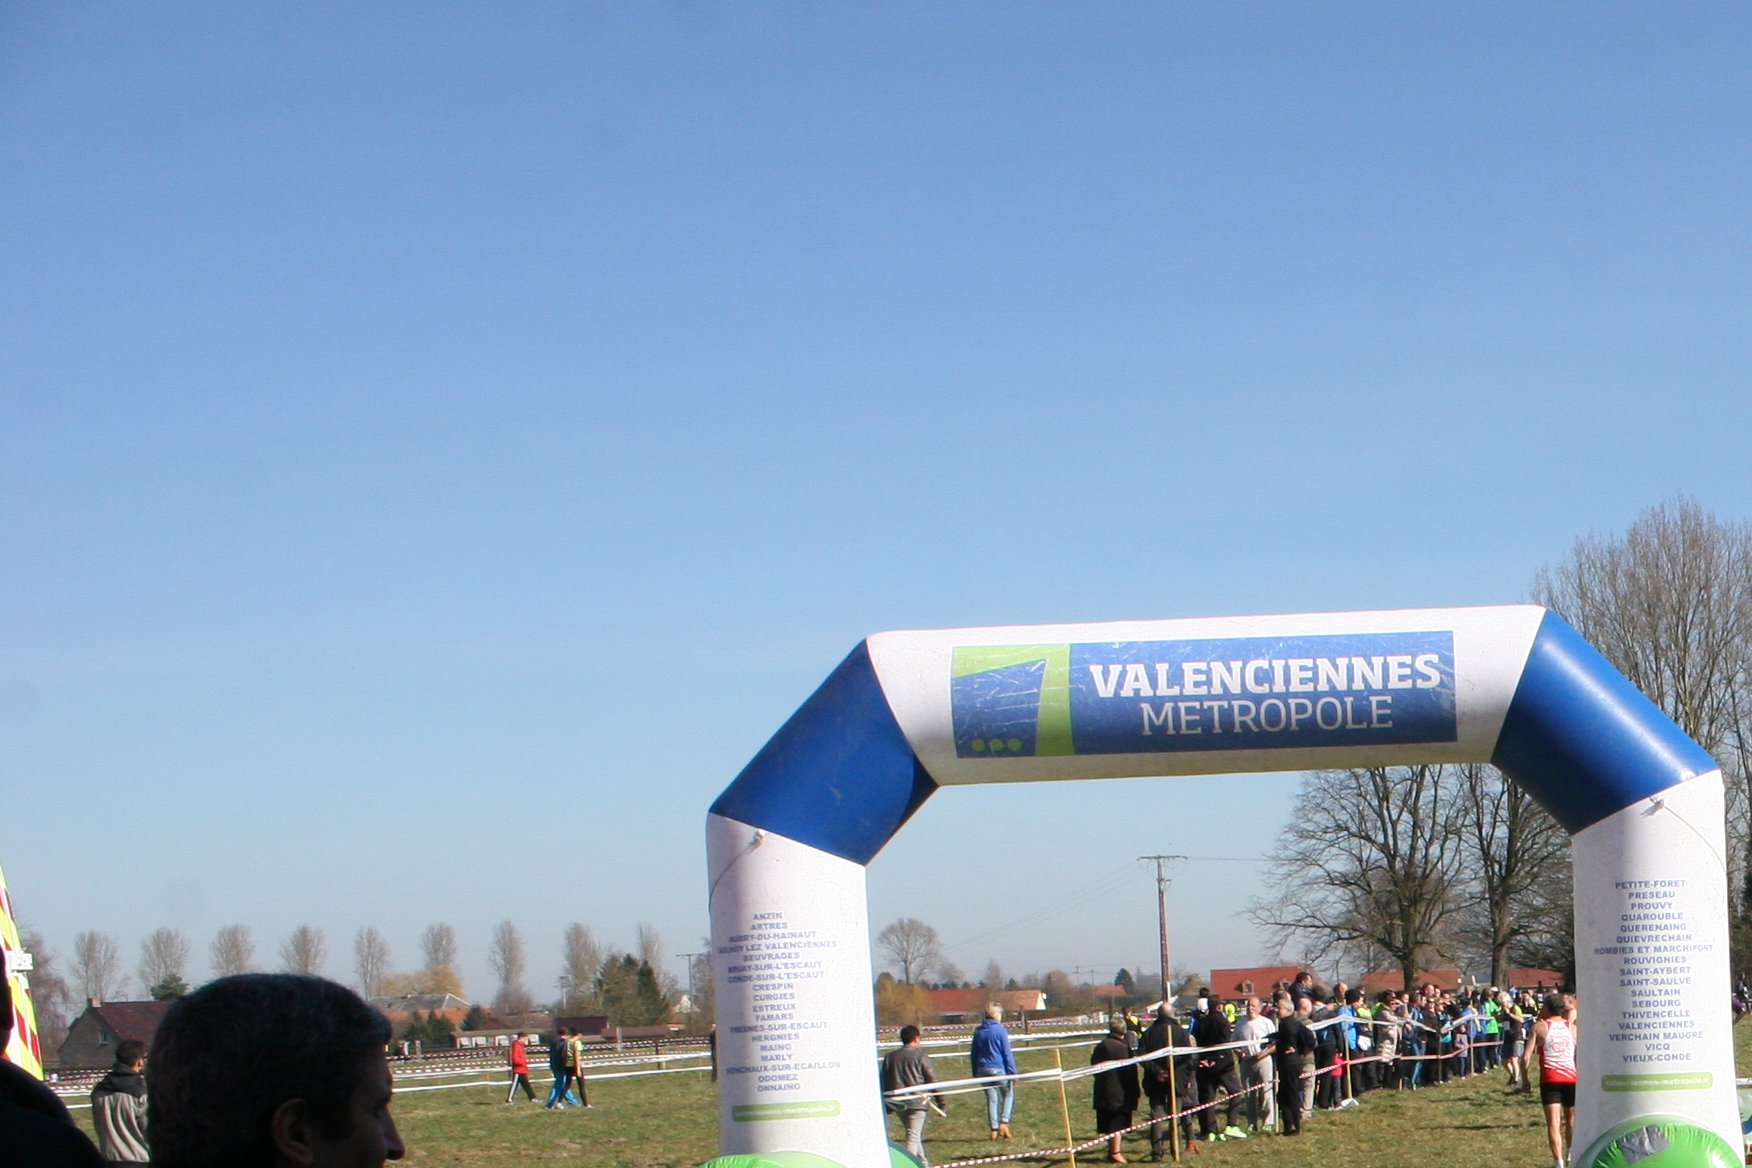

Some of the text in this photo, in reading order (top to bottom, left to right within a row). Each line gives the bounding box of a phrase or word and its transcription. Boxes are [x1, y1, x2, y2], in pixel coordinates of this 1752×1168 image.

[1090, 654, 1440, 698] VALENCIENNES
[1141, 696, 1393, 736] METROPOLE
[1615, 881, 1687, 890] PETITE-FORET
[1628, 891, 1676, 900] PRESEAU
[1631, 902, 1674, 911] PROUVY
[753, 913, 783, 921] ANZIN
[1621, 912, 1684, 922] QUAROUBLE
[751, 922, 788, 931] ARTRES
[1620, 923, 1688, 933] QUERENAING
[1616, 934, 1692, 944] QUIEVRECHAIN
[1594, 944, 1714, 956] ROMBIES ET MARCHIPONT
[743, 953, 801, 962] BEUVRAGES
[1624, 956, 1687, 965] ROUVIGNIES
[1620, 967, 1692, 976] SAINT-AYBERT
[1620, 977, 1692, 987] SAINT-SAULVE
[753, 983, 794, 992] CRESPIN
[753, 993, 796, 1002] CURGIES
[1631, 988, 1681, 998] SAULTAIN
[753, 1003, 797, 1013] ESTREUX
[1632, 999, 1682, 1009] SEBOURG
[756, 1013, 795, 1022] FAMARS
[1622, 1010, 1691, 1020] THIVENCELLE
[1619, 1021, 1695, 1031] VALENCIENNES
[752, 1033, 801, 1043] HERGNIES
[1609, 1031, 1704, 1042] VERCHAIN MAUGRE
[760, 1043, 792, 1052] MAING
[1645, 1043, 1671, 1053] VICQ
[761, 1054, 793, 1062] MARLY
[1623, 1054, 1692, 1063] VIEUX-CONDE
[758, 1074, 799, 1083] ODOMEZ
[757, 1084, 801, 1093] ONNAING
